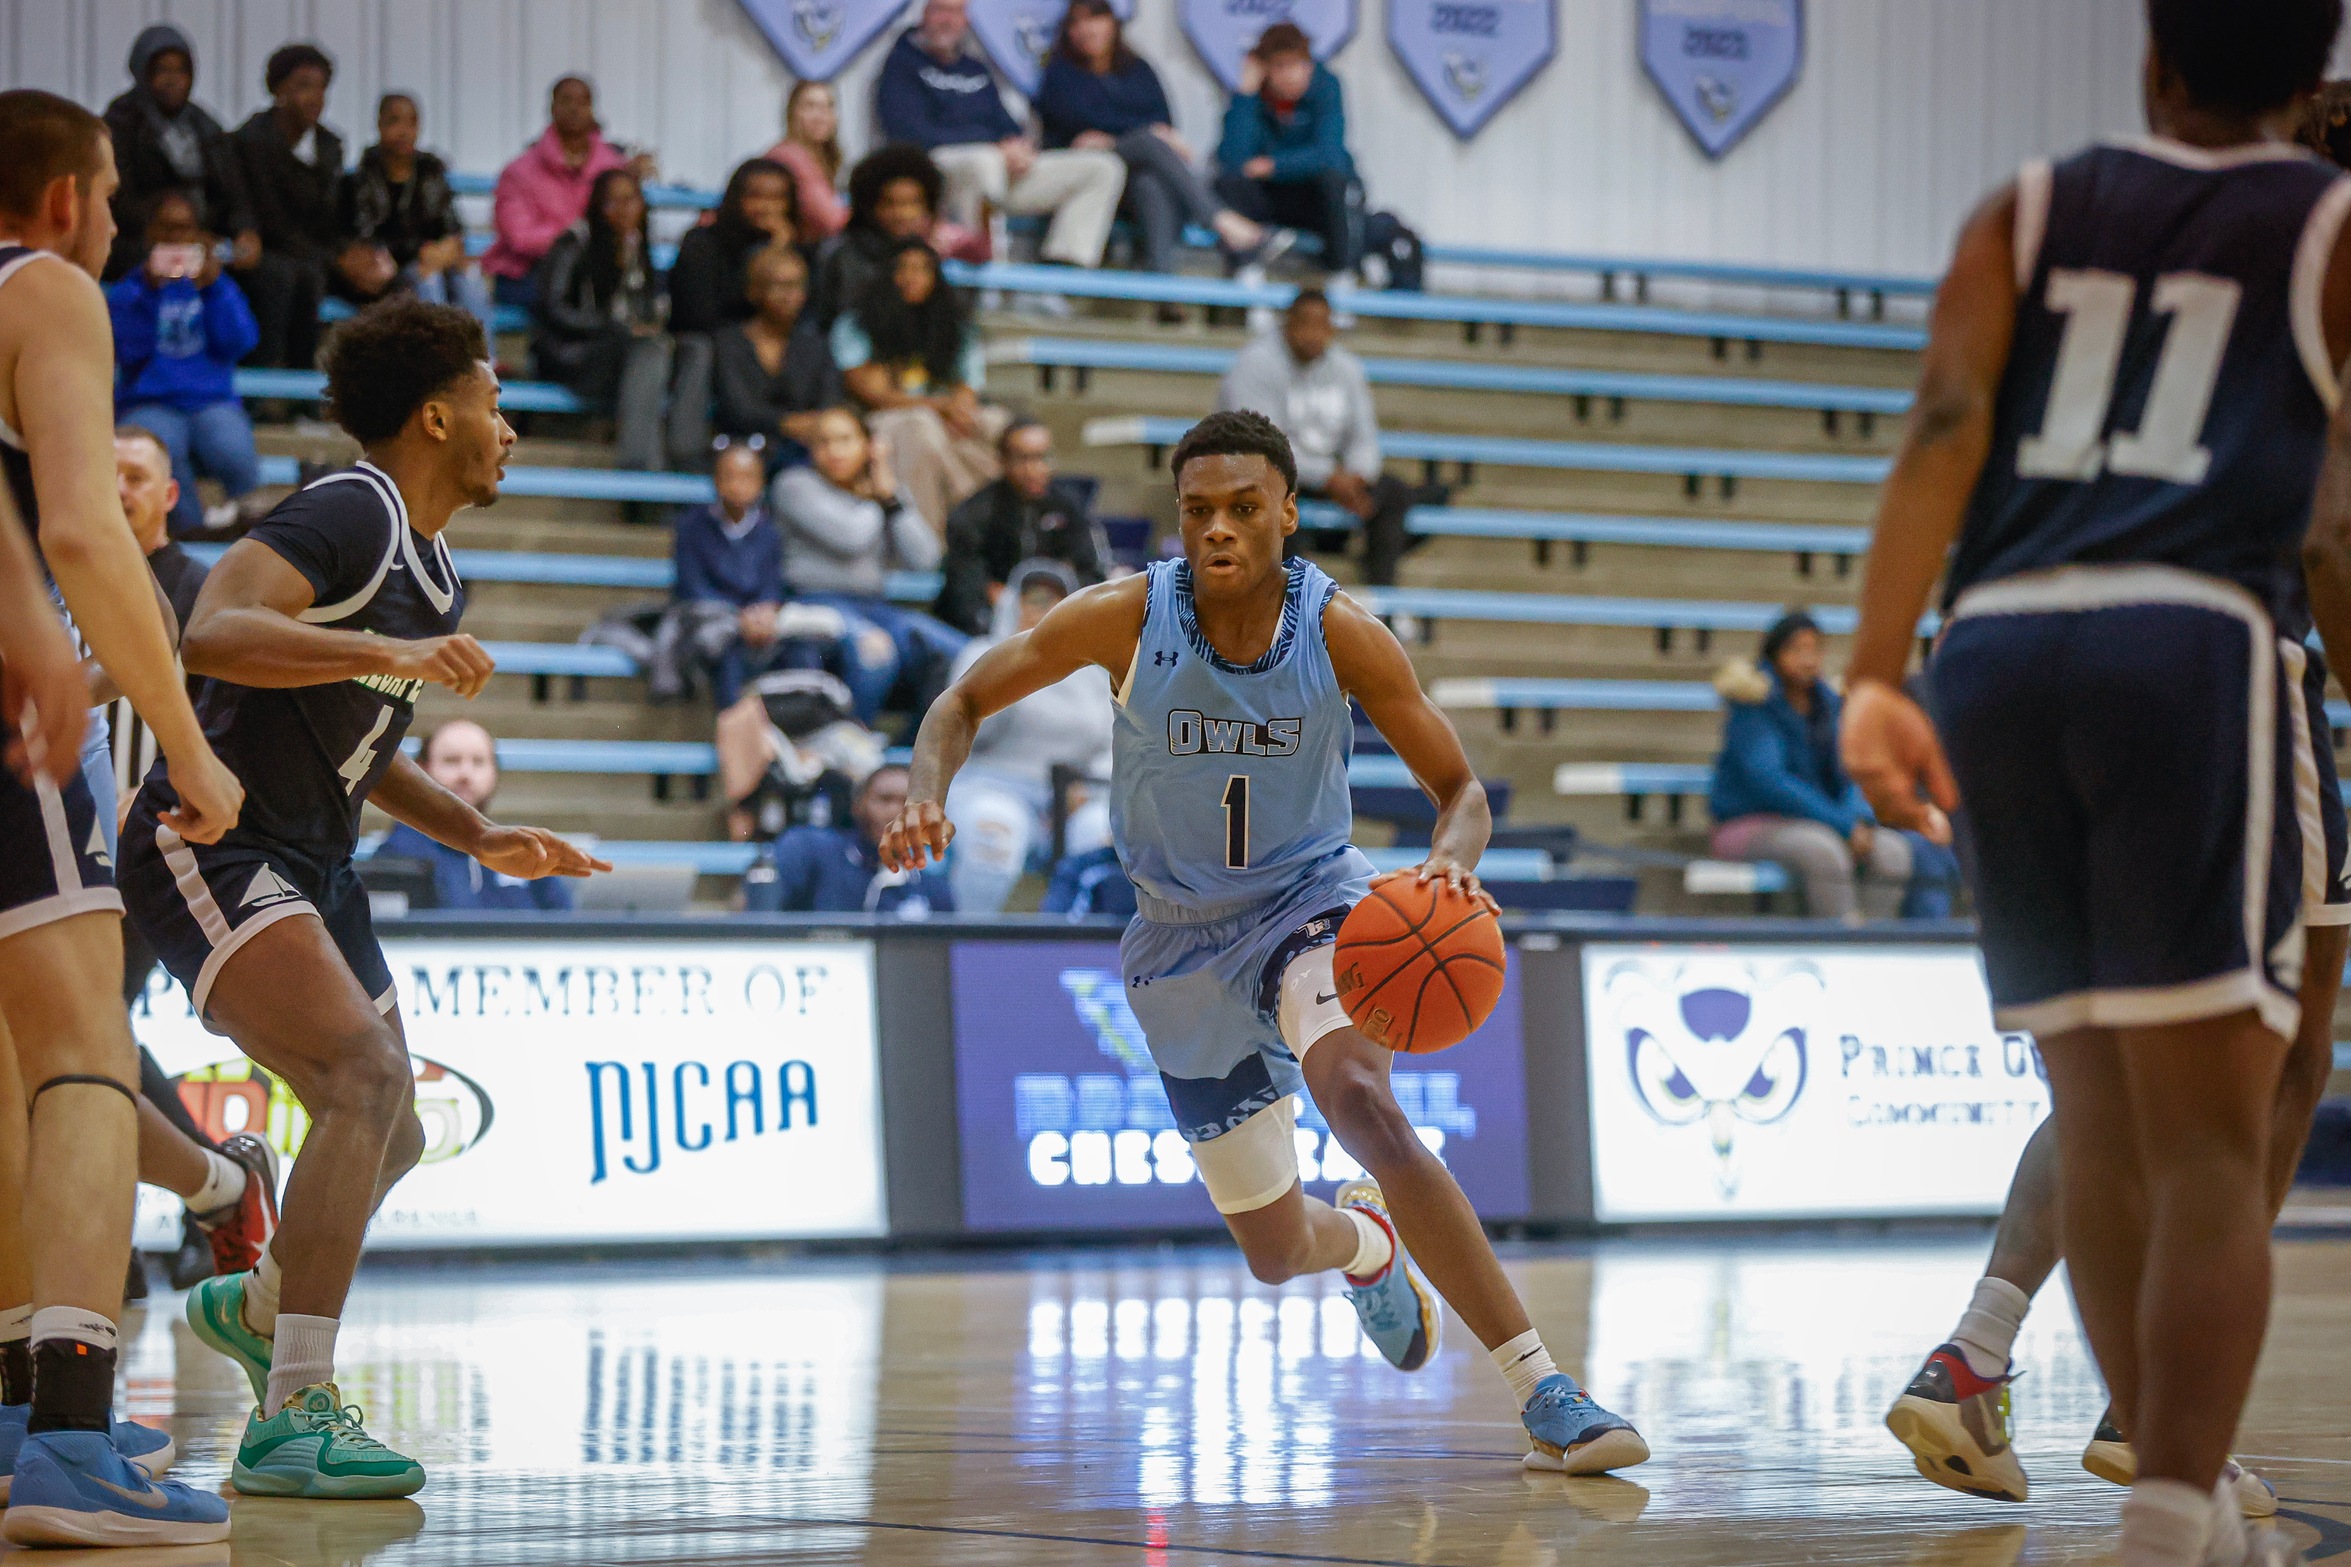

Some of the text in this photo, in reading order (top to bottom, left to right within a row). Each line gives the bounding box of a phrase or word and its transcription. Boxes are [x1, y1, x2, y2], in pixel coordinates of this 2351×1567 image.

[2014, 267, 2243, 485] 11
[338, 704, 394, 796] 4
[1168, 709, 1302, 757] OWLS
[1221, 774, 1250, 869] 1
[411, 963, 829, 1016] MEMBER OF
[585, 1060, 818, 1185] NJCAA
